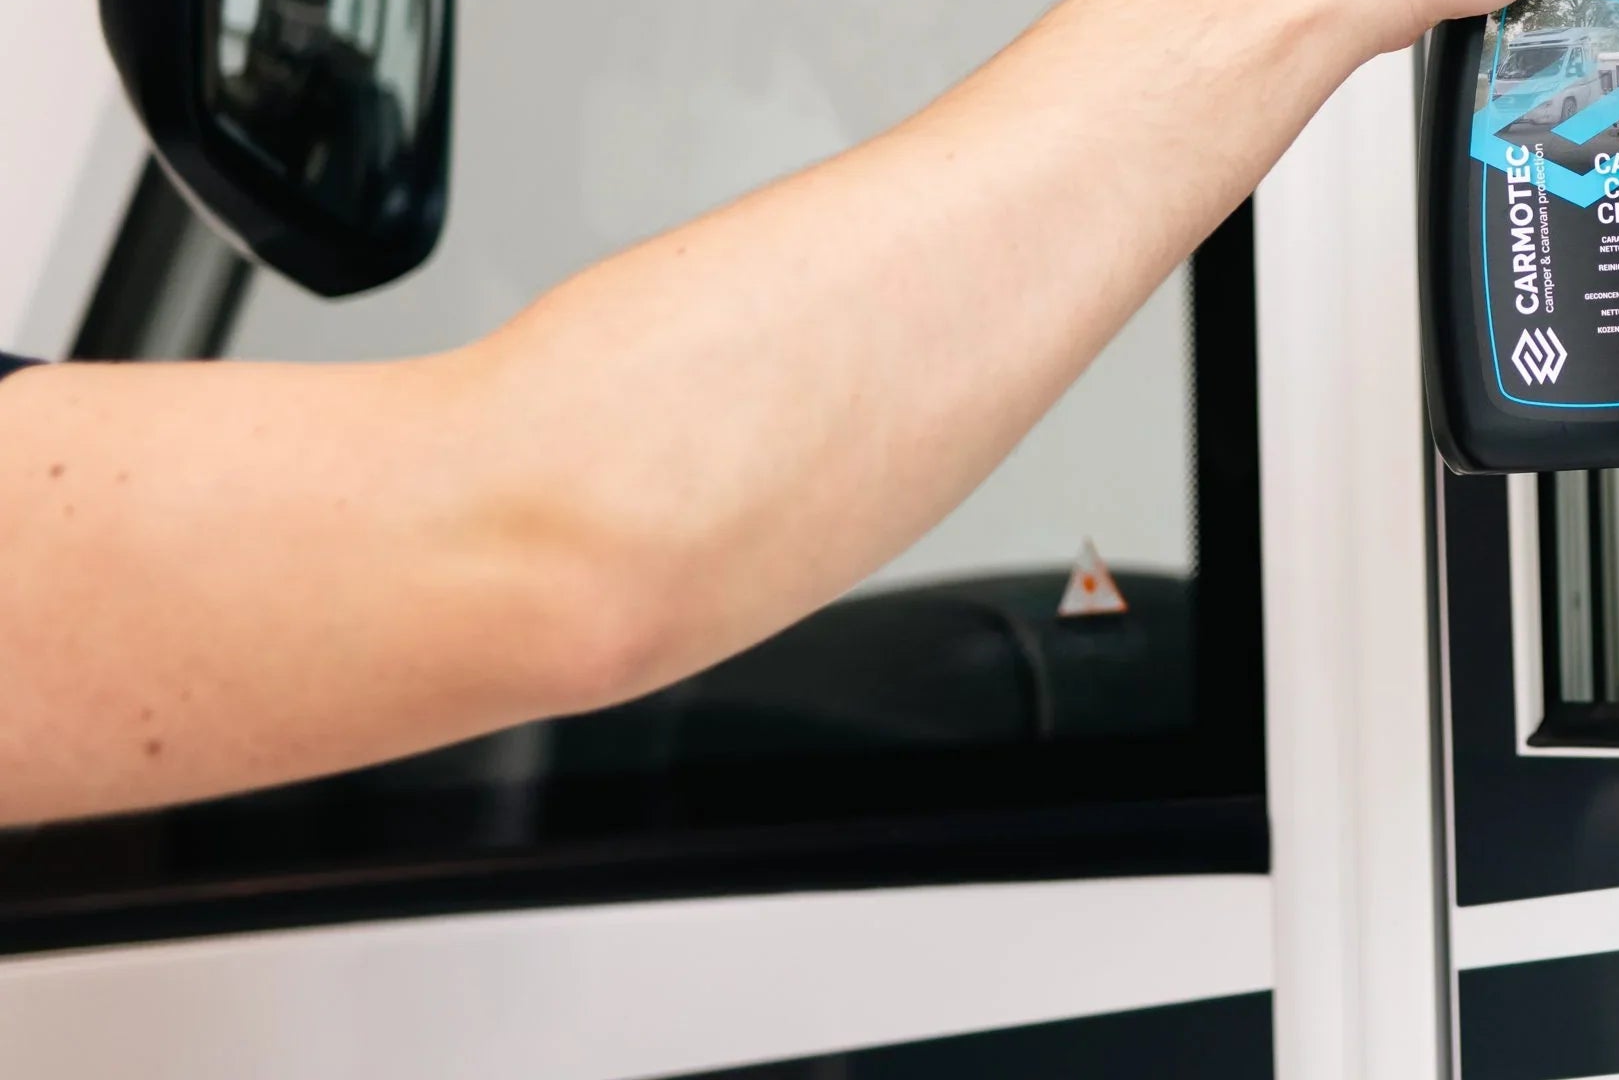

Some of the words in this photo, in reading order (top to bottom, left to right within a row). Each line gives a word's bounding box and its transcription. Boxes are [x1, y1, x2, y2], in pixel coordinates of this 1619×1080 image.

[1534, 143, 1549, 204] protection
[1505, 144, 1539, 315] CARMOTEC
[1538, 206, 1551, 253] caravan
[1541, 256, 1551, 265] &
[1543, 267, 1555, 313] camper
